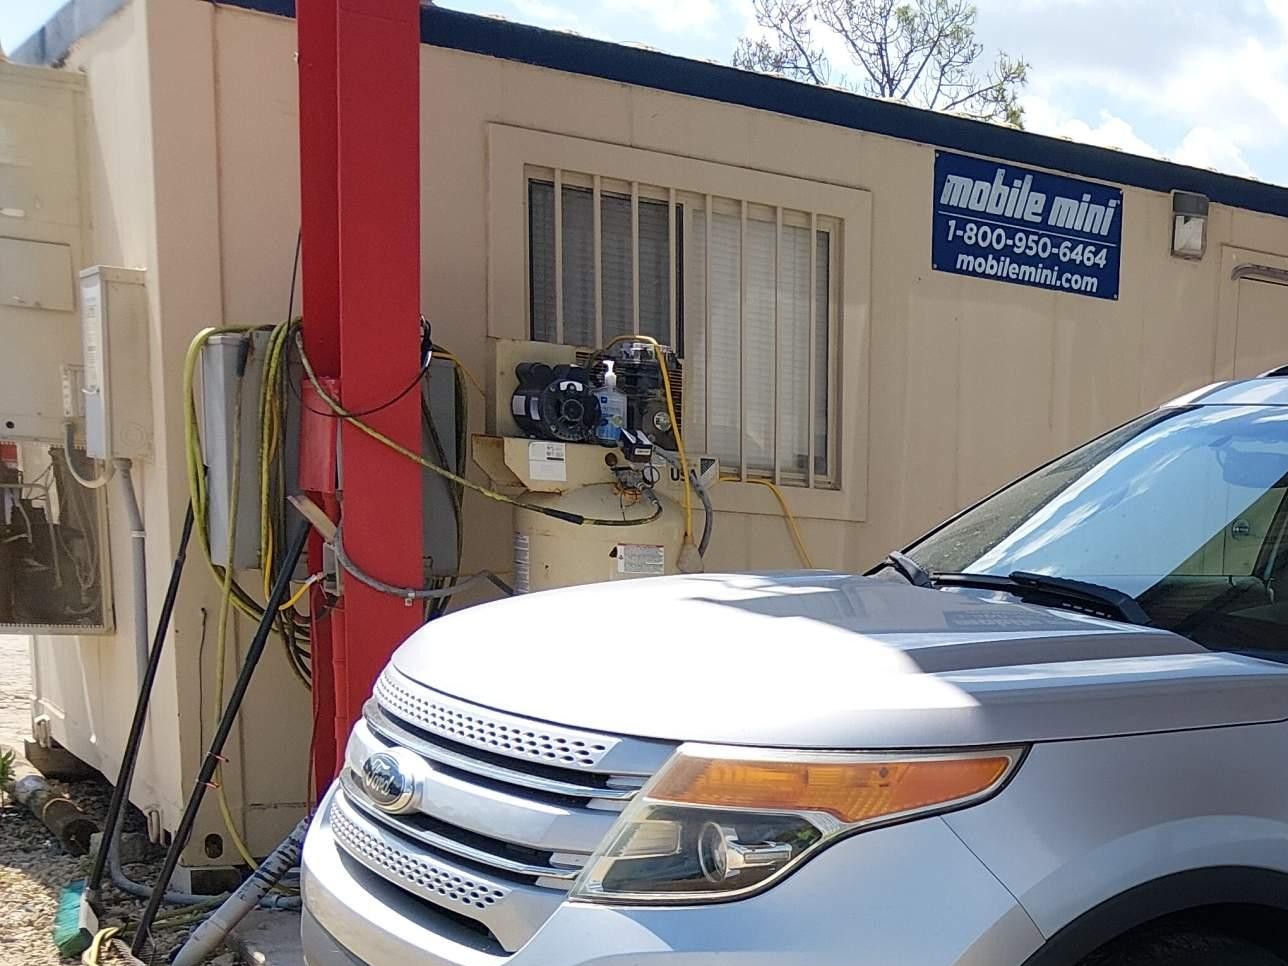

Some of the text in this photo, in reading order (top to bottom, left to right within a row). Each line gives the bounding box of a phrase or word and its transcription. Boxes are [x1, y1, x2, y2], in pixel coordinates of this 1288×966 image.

[940, 168, 1117, 236] mobile mini
[947, 219, 1107, 268] 1-800-950-6464
[955, 253, 1098, 292] mobilemini.com
[366, 758, 395, 796] Ford
